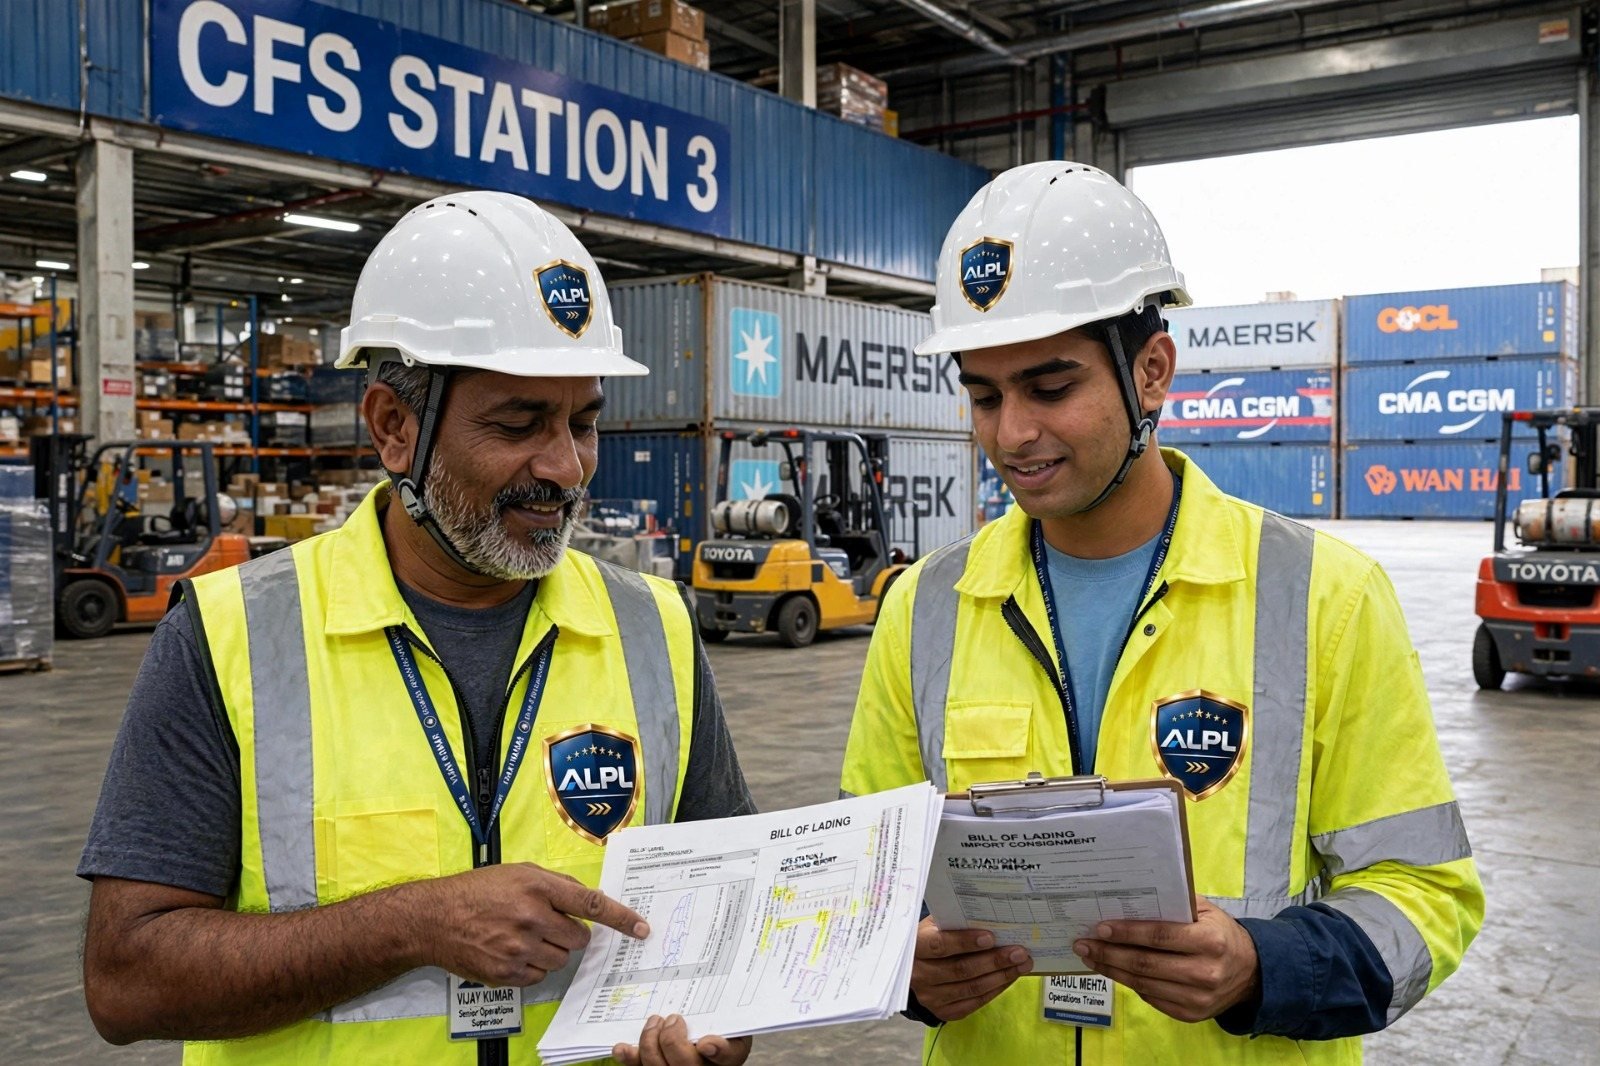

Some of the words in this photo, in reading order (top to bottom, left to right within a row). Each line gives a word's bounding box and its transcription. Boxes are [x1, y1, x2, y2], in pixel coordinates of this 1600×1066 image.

[178, 0, 362, 132] CFS
[388, 55, 668, 201] STATION
[686, 135, 718, 213] 3
[963, 261, 1006, 280] ALPL
[547, 288, 590, 304] ALPL
[1188, 320, 1316, 348] MAERSK
[795, 332, 956, 396] MAERSK
[1182, 397, 1238, 420] CMA
[1241, 396, 1300, 418] CGM
[1378, 391, 1443, 415] CMA
[1447, 388, 1515, 412] CGM
[1400, 468, 1464, 492] WAN
[704, 547, 754, 560] TOYOTA
[1508, 563, 1600, 582] TOYOTA
[1160, 729, 1237, 752] ALPL
[557, 766, 633, 791] ALPL
[770, 828, 792, 840] BILL
[795, 824, 809, 836] OF
[812, 816, 851, 832] LADING
[1000, 833, 1018, 841] OF
[1023, 830, 1075, 840] LADING
[1008, 837, 1096, 848] CONSIGNMENT
[1050, 975, 1078, 989] RAHUL
[1080, 977, 1107, 992] MEHTA
[457, 991, 481, 1005] VIJAY
[483, 989, 514, 1003] KUMAR
[1048, 992, 1081, 1004] Operations
[458, 1008, 479, 1018] Senior
